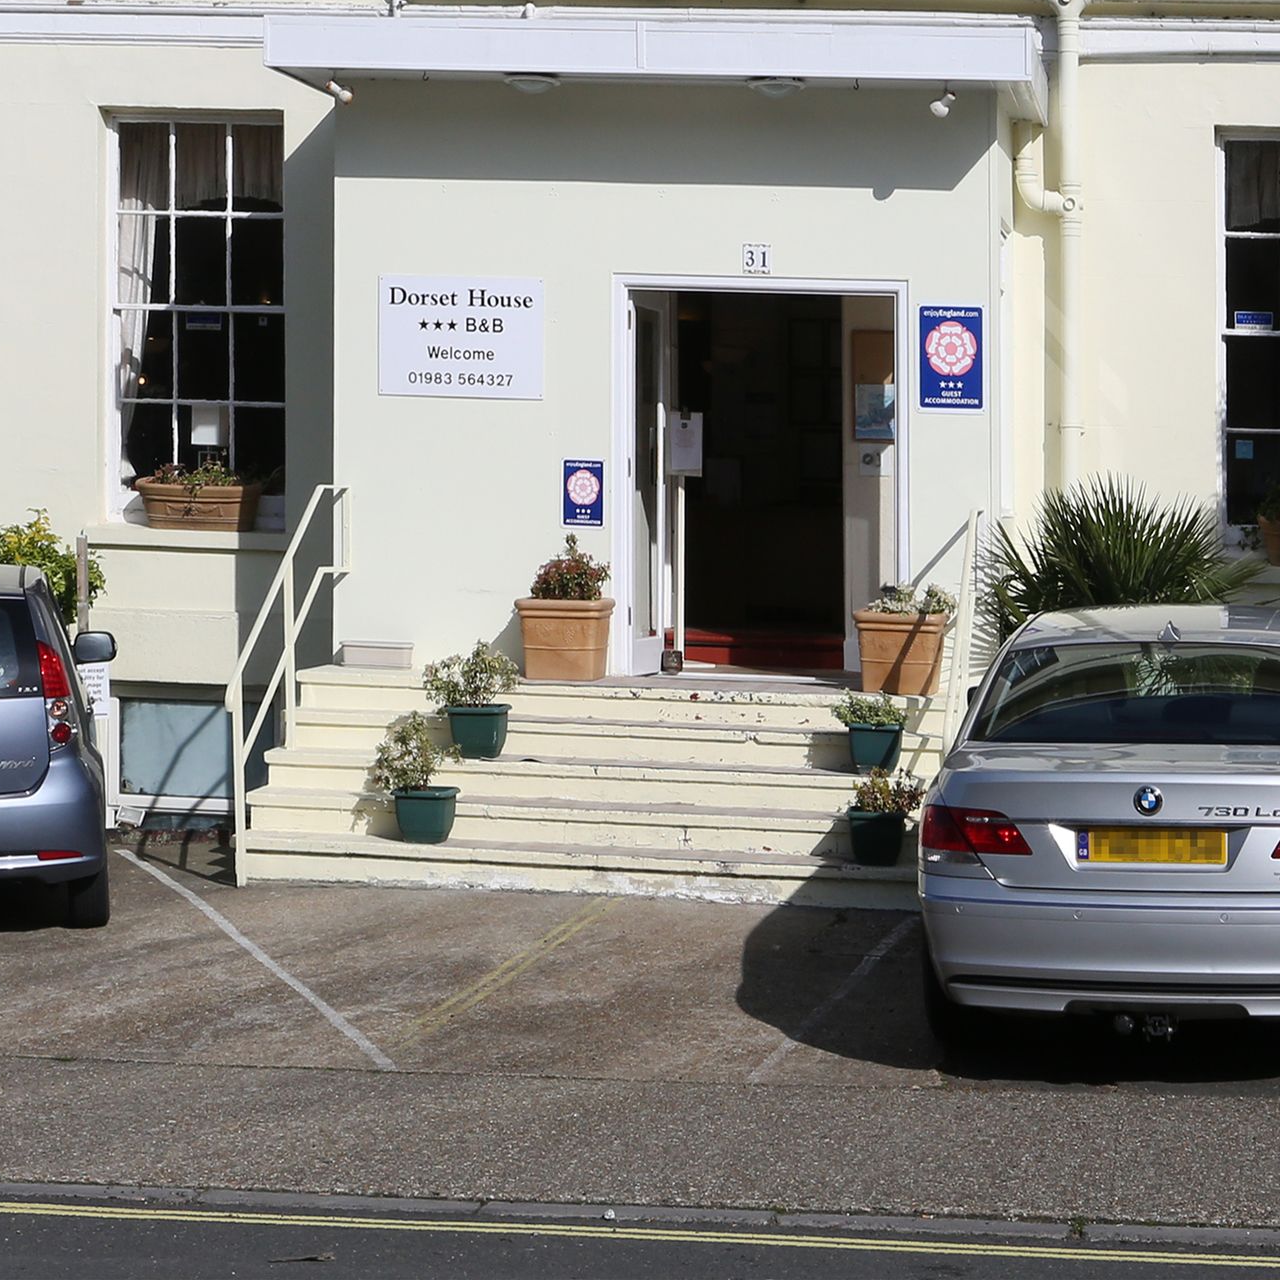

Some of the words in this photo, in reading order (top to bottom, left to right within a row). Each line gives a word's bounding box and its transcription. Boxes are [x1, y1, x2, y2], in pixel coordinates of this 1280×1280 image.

[745, 250, 768, 267] 31
[389, 286, 458, 306] Dorset
[467, 289, 534, 308] House
[923, 309, 979, 318] enjoyEngland.com
[466, 317, 504, 333] B&B
[427, 346, 495, 360] Welcome
[408, 371, 453, 385] 01983
[458, 373, 513, 386] 564327
[924, 397, 979, 405] ACCOMMODATION
[1198, 806, 1249, 817] 730
